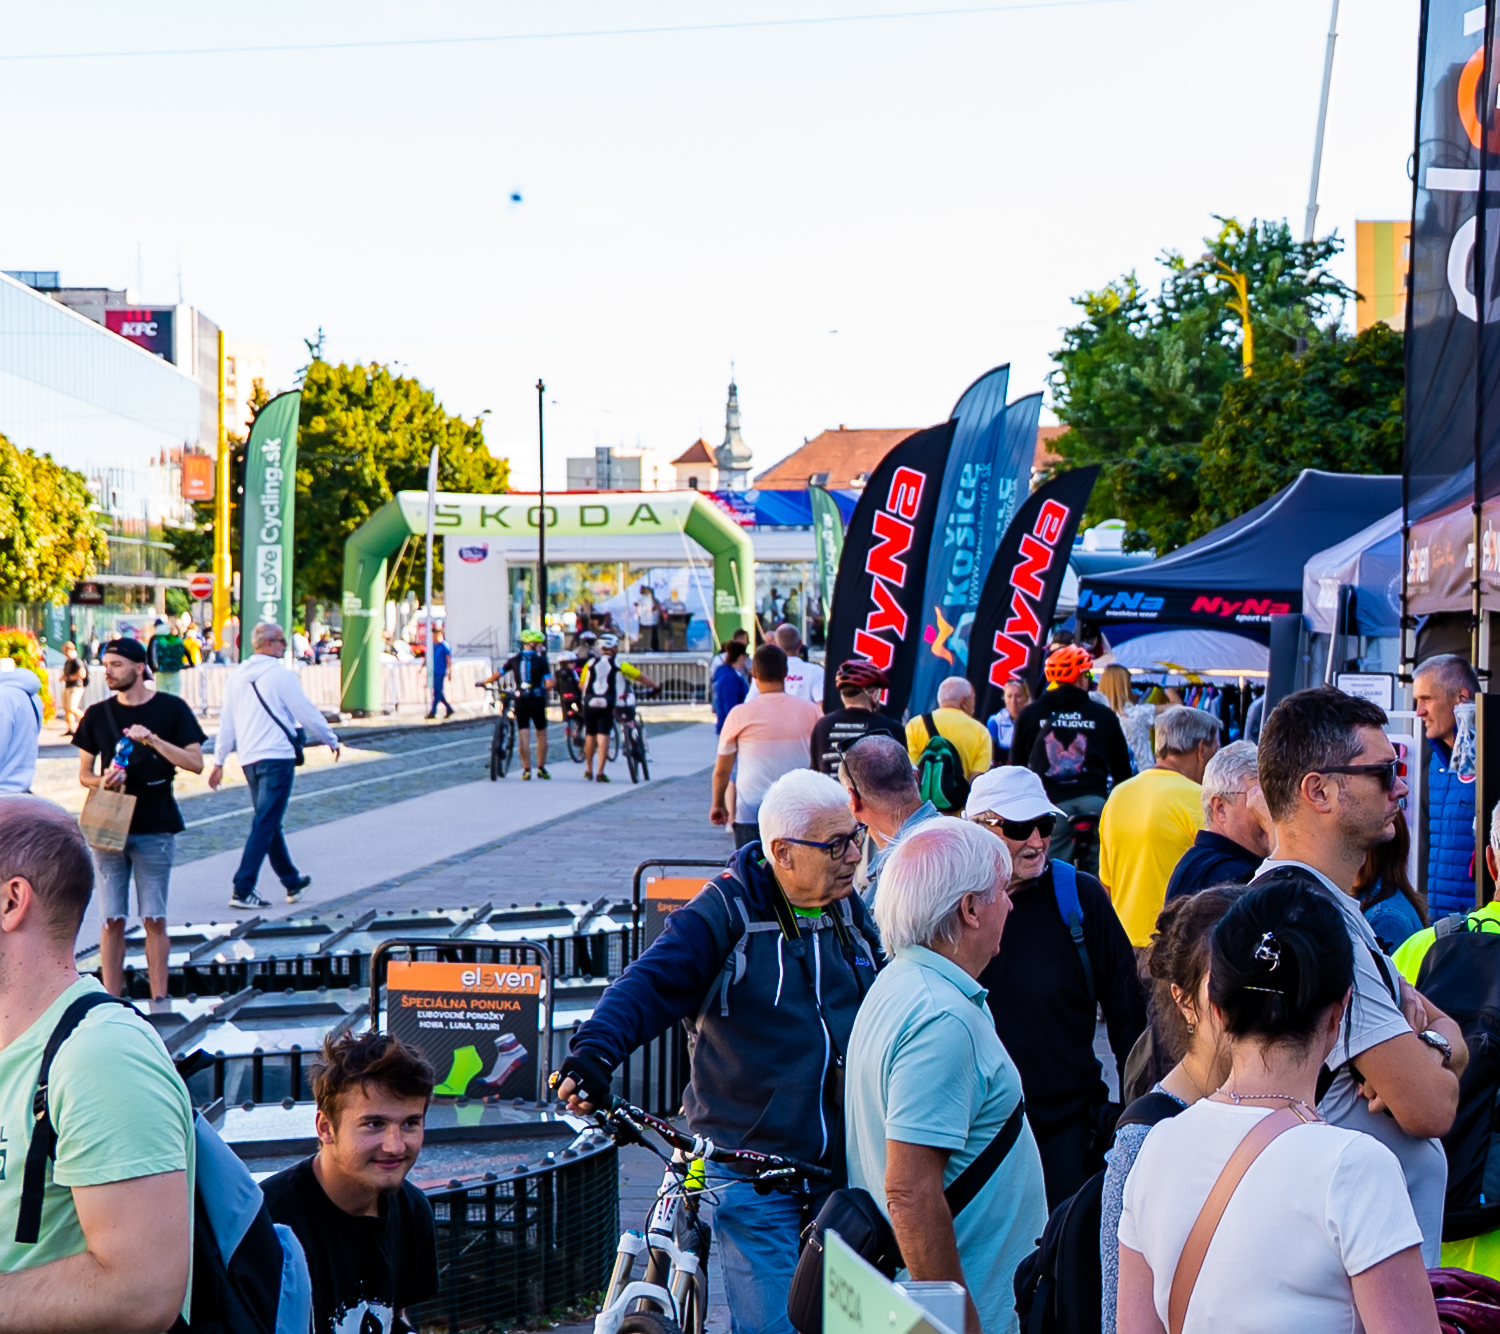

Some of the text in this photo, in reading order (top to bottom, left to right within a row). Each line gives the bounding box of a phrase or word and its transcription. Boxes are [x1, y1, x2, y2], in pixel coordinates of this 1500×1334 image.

[120, 322, 157, 337] KFC
[1052, 711, 1082, 720] ASIČI
[461, 967, 534, 988] eleven
[401, 995, 521, 1010] ŠPECIÁLNA PONUKA
